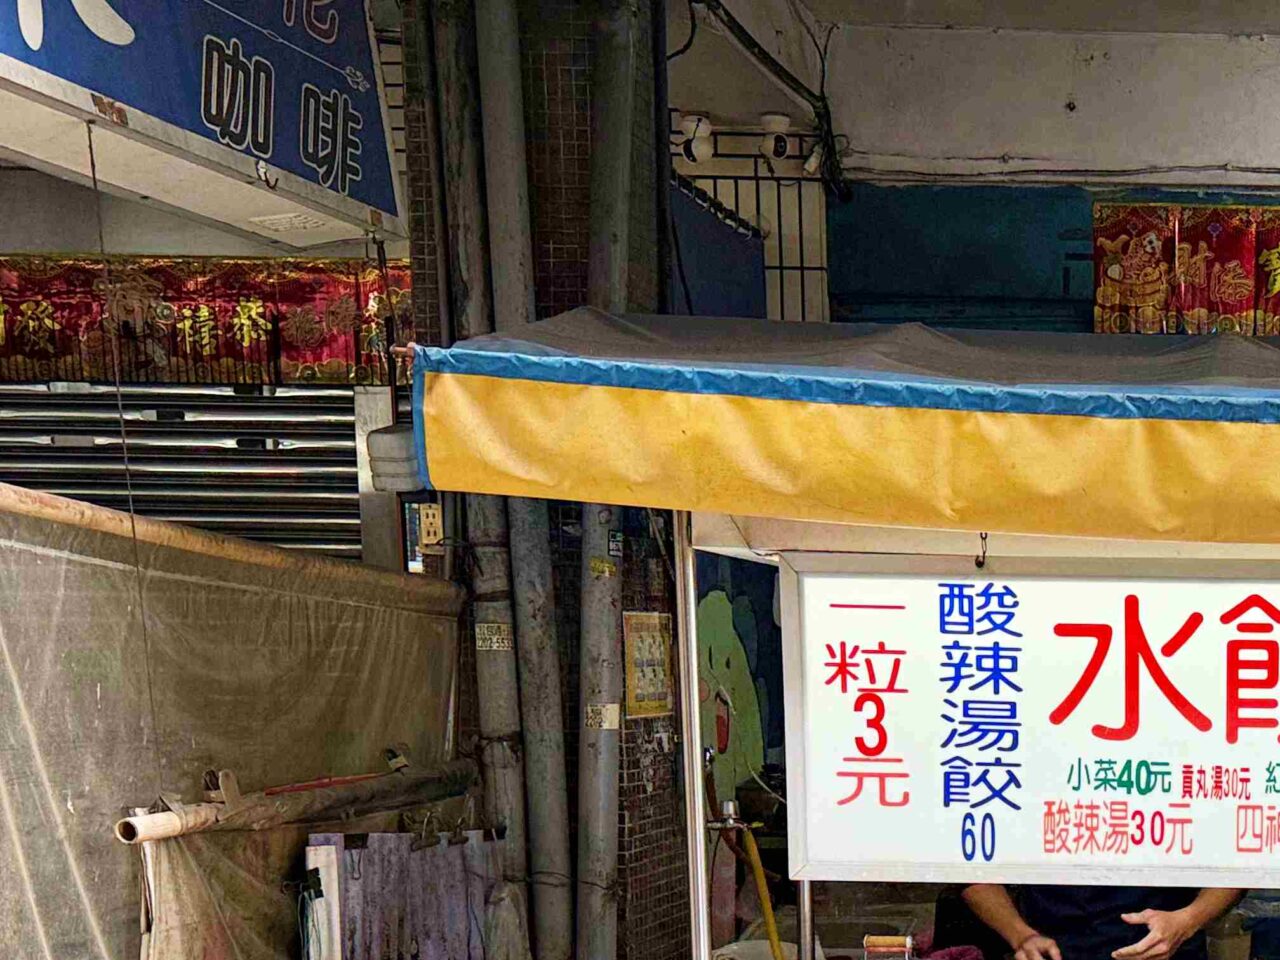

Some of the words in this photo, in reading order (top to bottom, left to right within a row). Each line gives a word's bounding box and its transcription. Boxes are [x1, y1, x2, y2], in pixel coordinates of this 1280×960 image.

[201, 34, 364, 196] 咖啡
[824, 603, 910, 807] 一粒3元
[938, 583, 1023, 811] 酸辣湯餃
[1067, 758, 1172, 795] 小菜40元
[1181, 764, 1251, 801] 貢丸湯30元
[961, 812, 996, 862] 60
[1043, 800, 1194, 855] 酸辣湯30元
